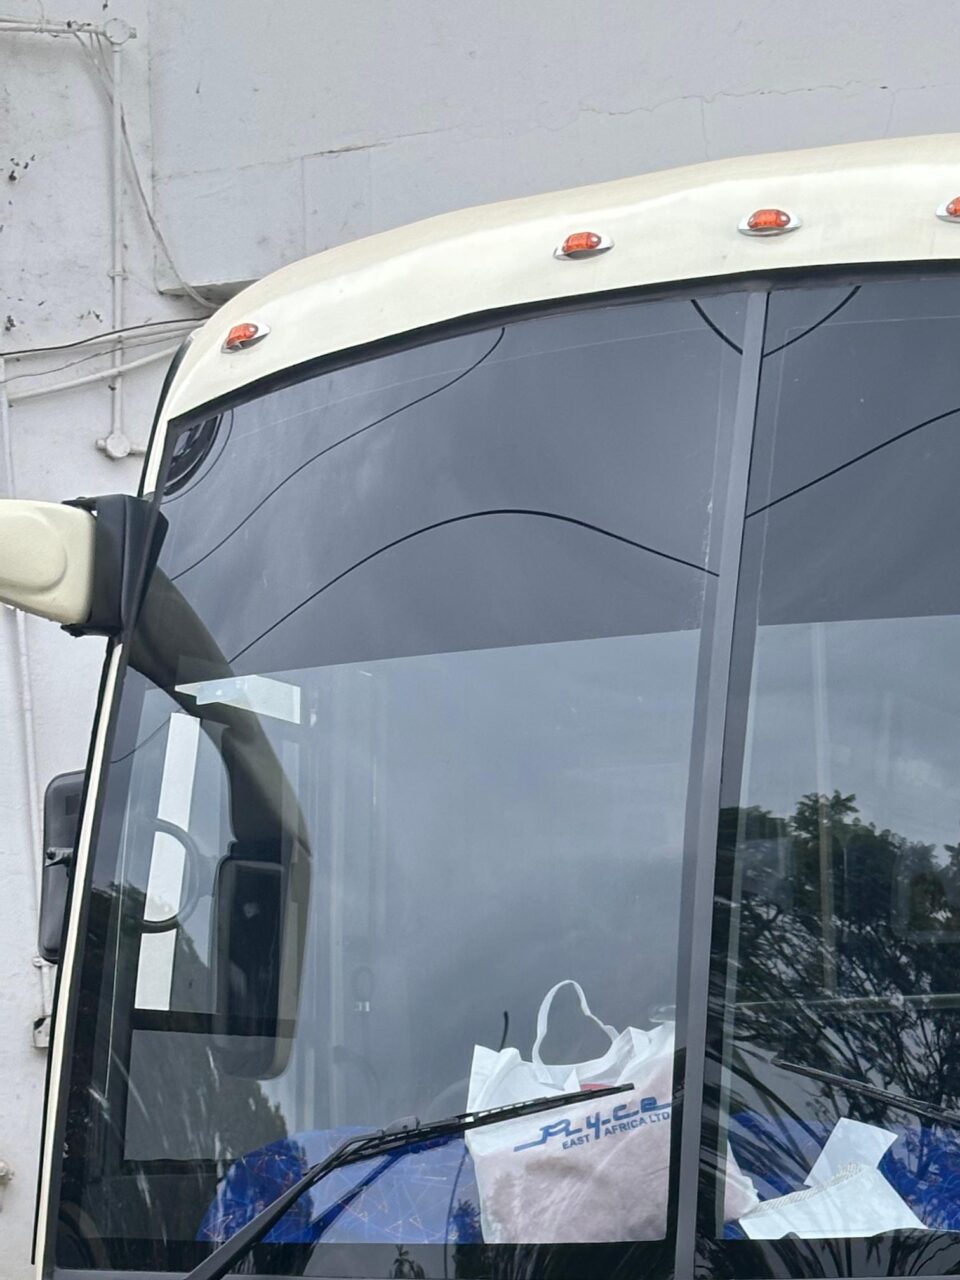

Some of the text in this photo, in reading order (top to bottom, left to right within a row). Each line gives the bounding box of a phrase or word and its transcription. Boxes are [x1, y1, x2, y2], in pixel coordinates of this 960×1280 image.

[514, 1096, 672, 1152] Ryce
[562, 1111, 670, 1150] EAST AFRICA LTD
